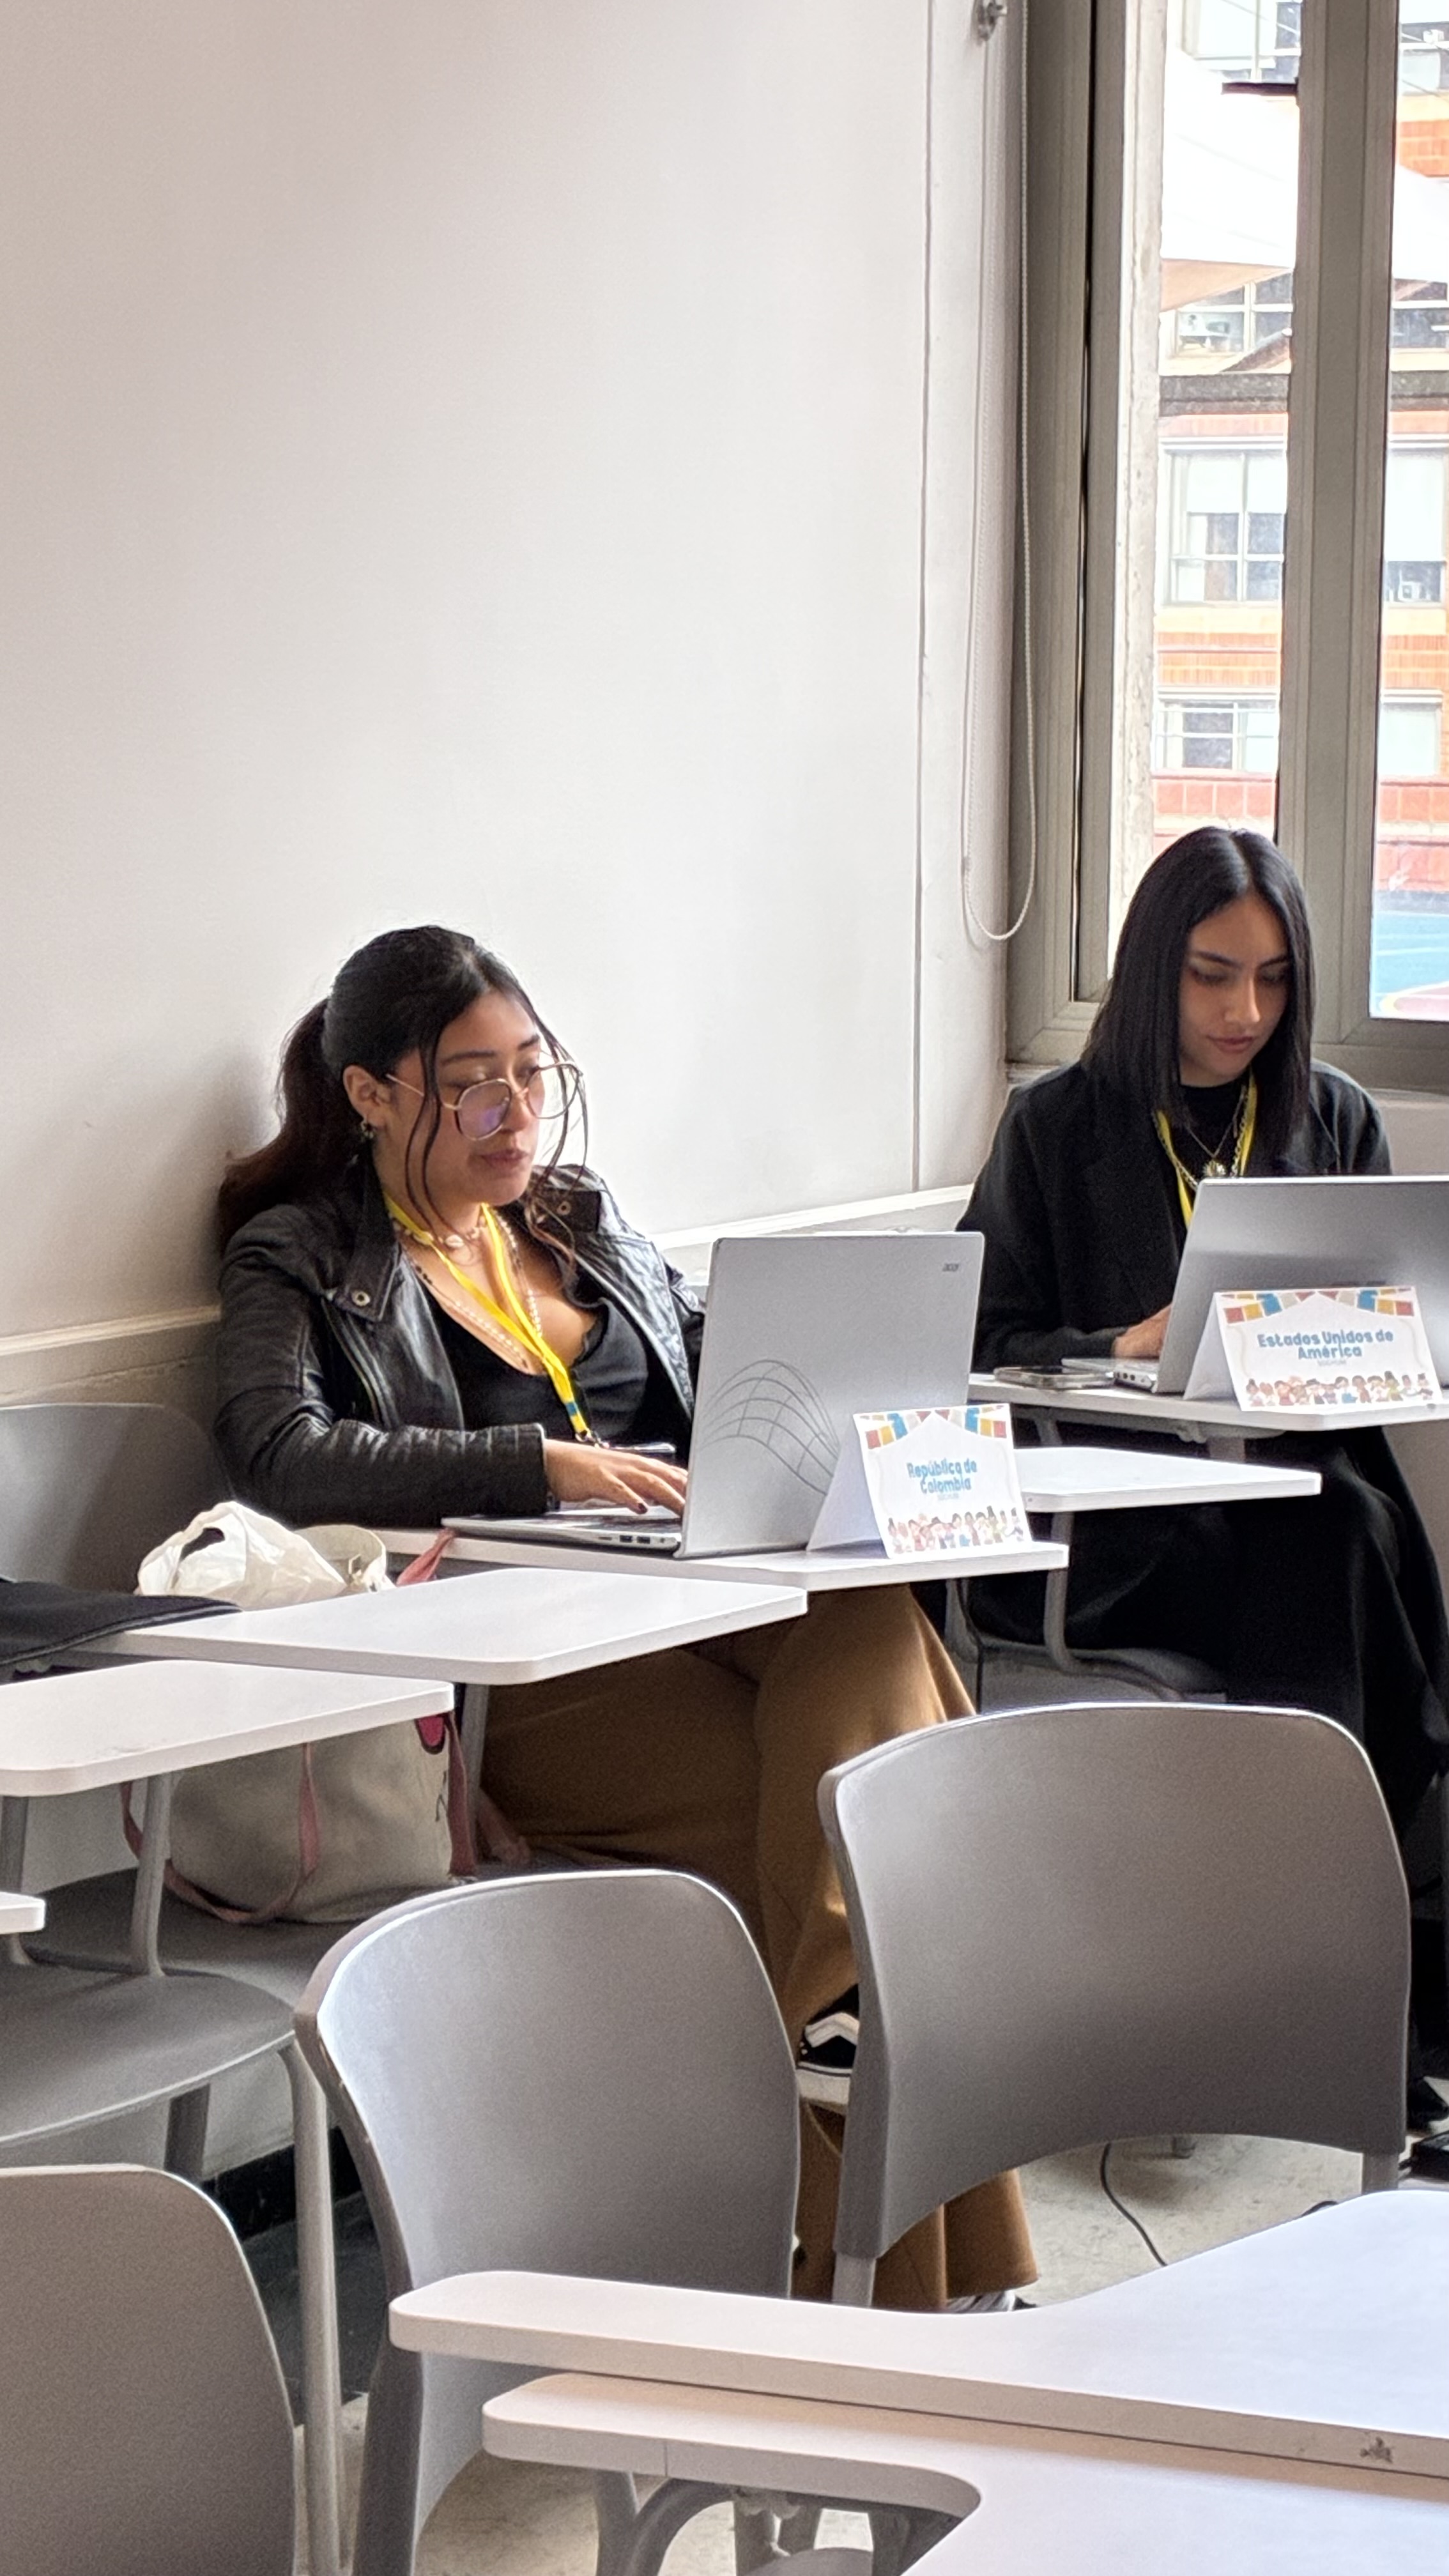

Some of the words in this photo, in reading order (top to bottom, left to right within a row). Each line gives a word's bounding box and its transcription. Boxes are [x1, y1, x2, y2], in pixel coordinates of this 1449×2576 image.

[1257, 1333, 1321, 1348] Estados
[1321, 1330, 1373, 1345] Unidos
[1375, 1330, 1393, 1342] de
[1298, 1345, 1362, 1360] América
[906, 1457, 962, 1479] República
[963, 1457, 977, 1473] de
[920, 1476, 972, 1494] Colombia
